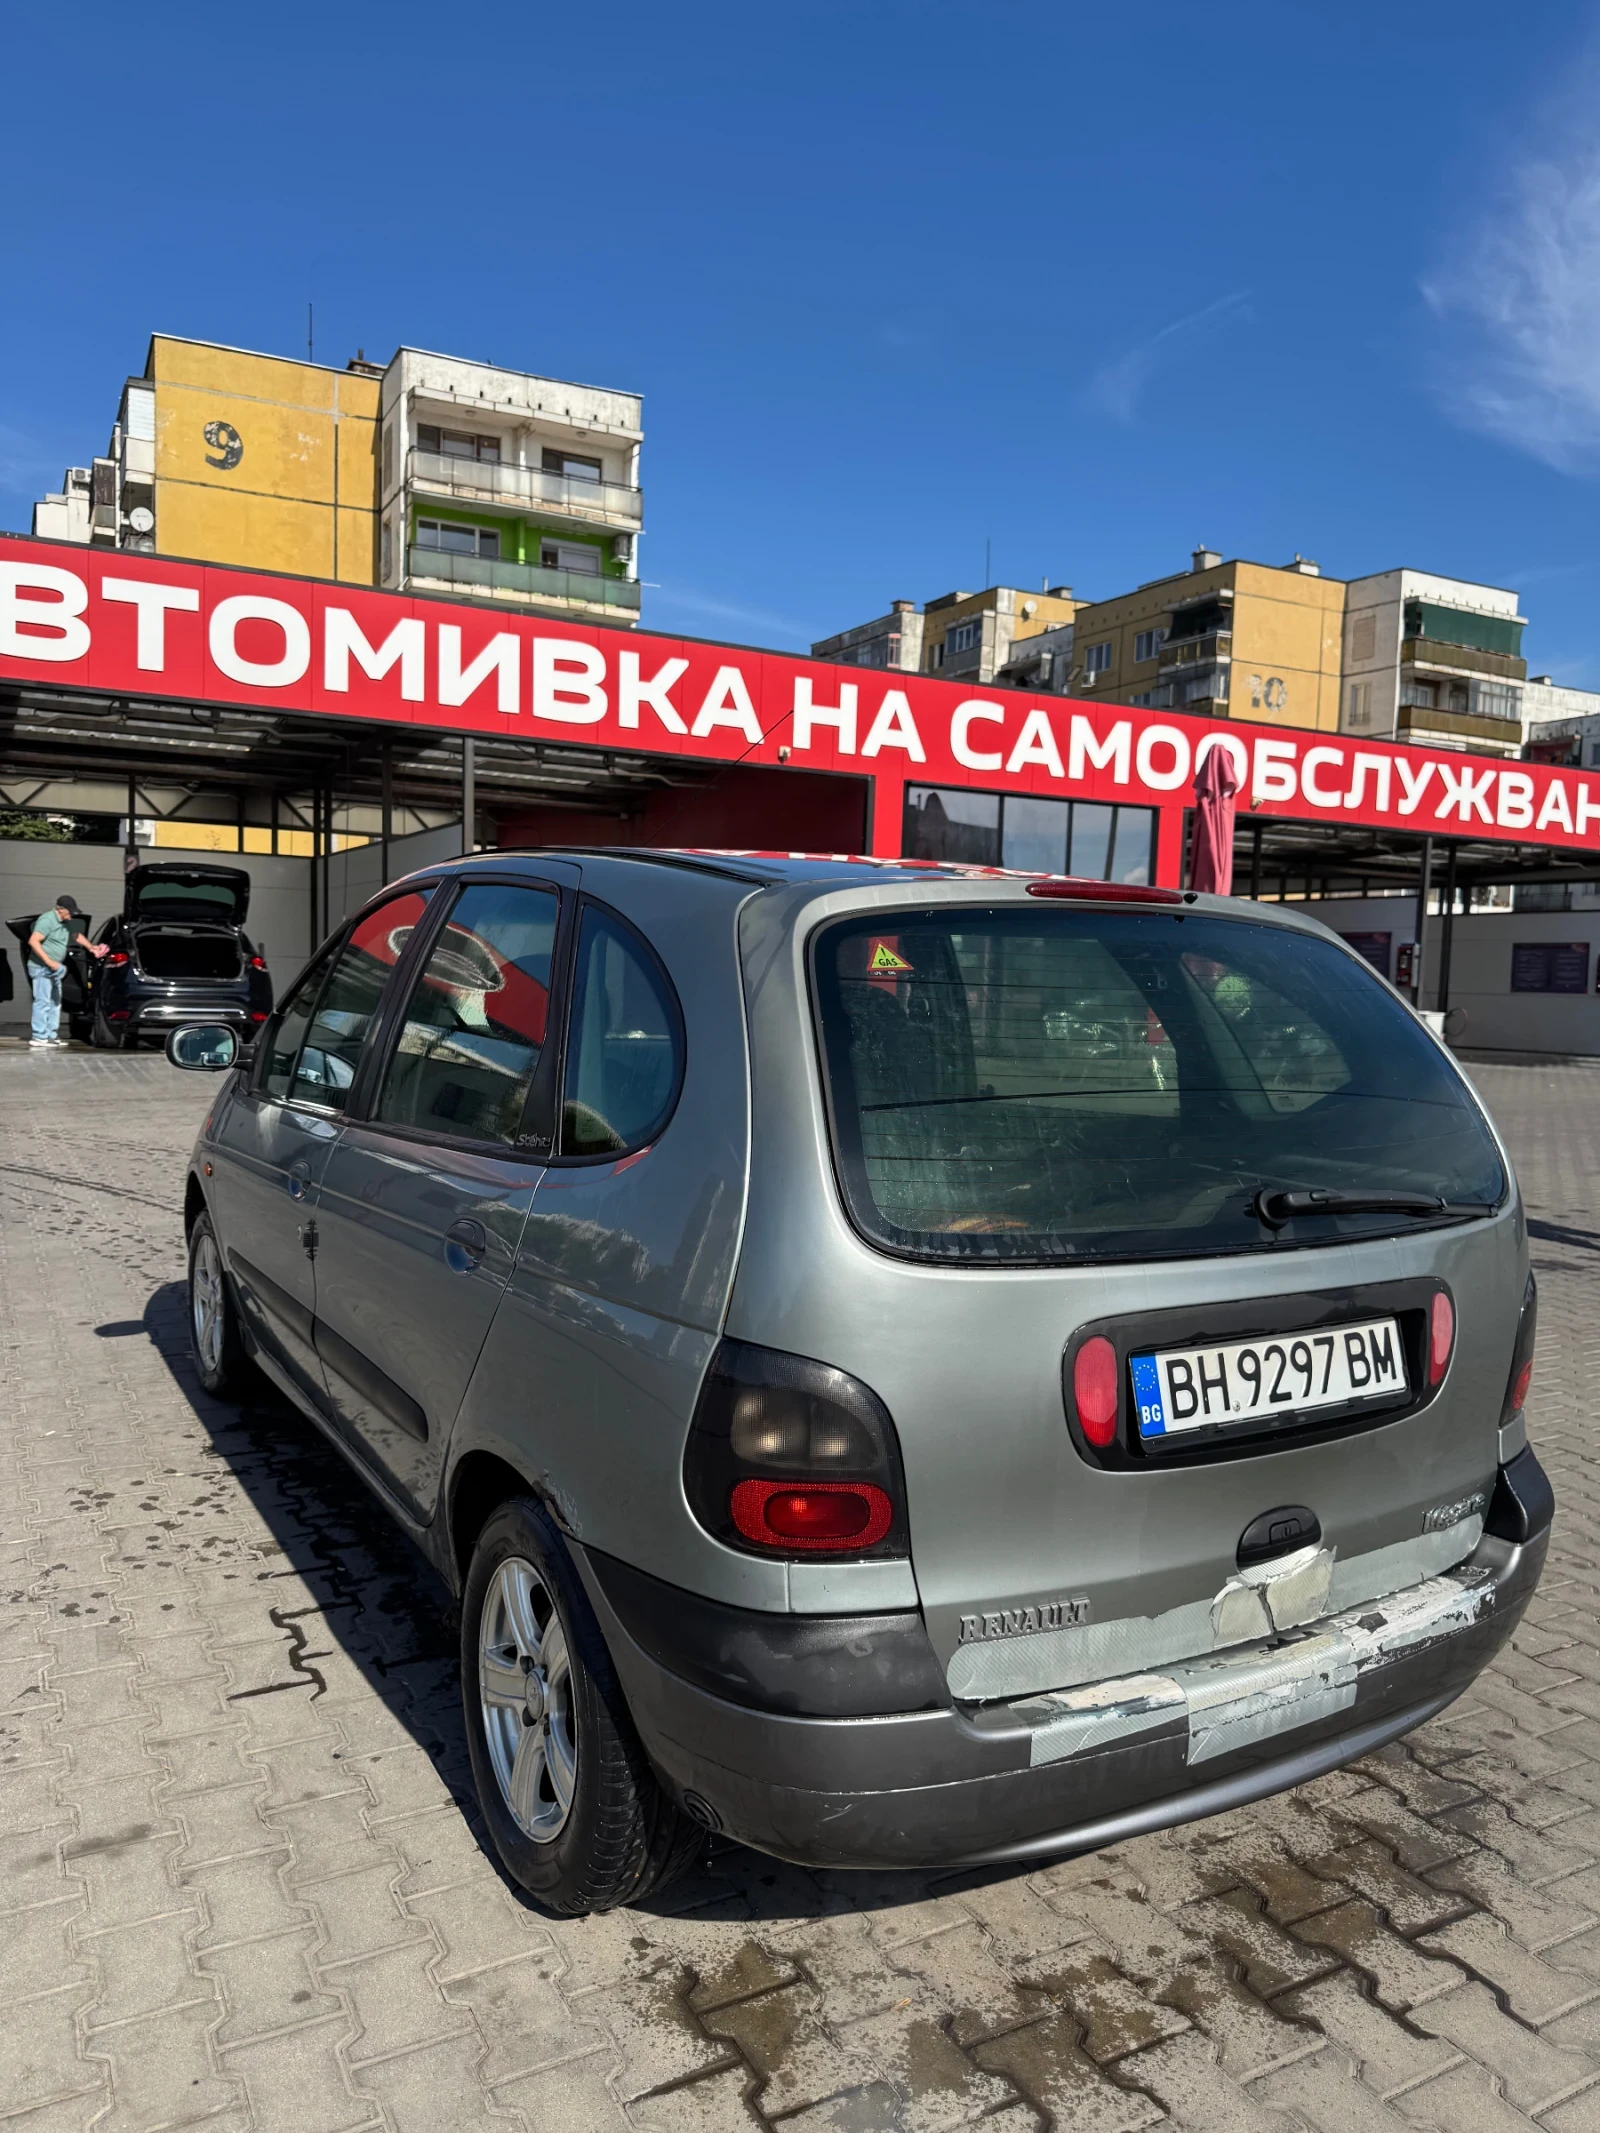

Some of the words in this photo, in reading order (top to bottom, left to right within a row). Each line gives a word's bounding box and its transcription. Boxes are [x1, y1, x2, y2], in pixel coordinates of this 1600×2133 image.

[203, 420, 244, 470] 9
[0, 560, 763, 745] ВТОМИВКА
[793, 677, 926, 763] НА
[1249, 674, 1288, 712] 10
[878, 958, 898, 967] GAS
[1165, 1351, 1230, 1420] BH
[1236, 1335, 1335, 1407] 9297
[1344, 1326, 1397, 1388] BM
[1141, 1403, 1161, 1424] BG
[959, 1597, 1091, 1643] RENAULT
